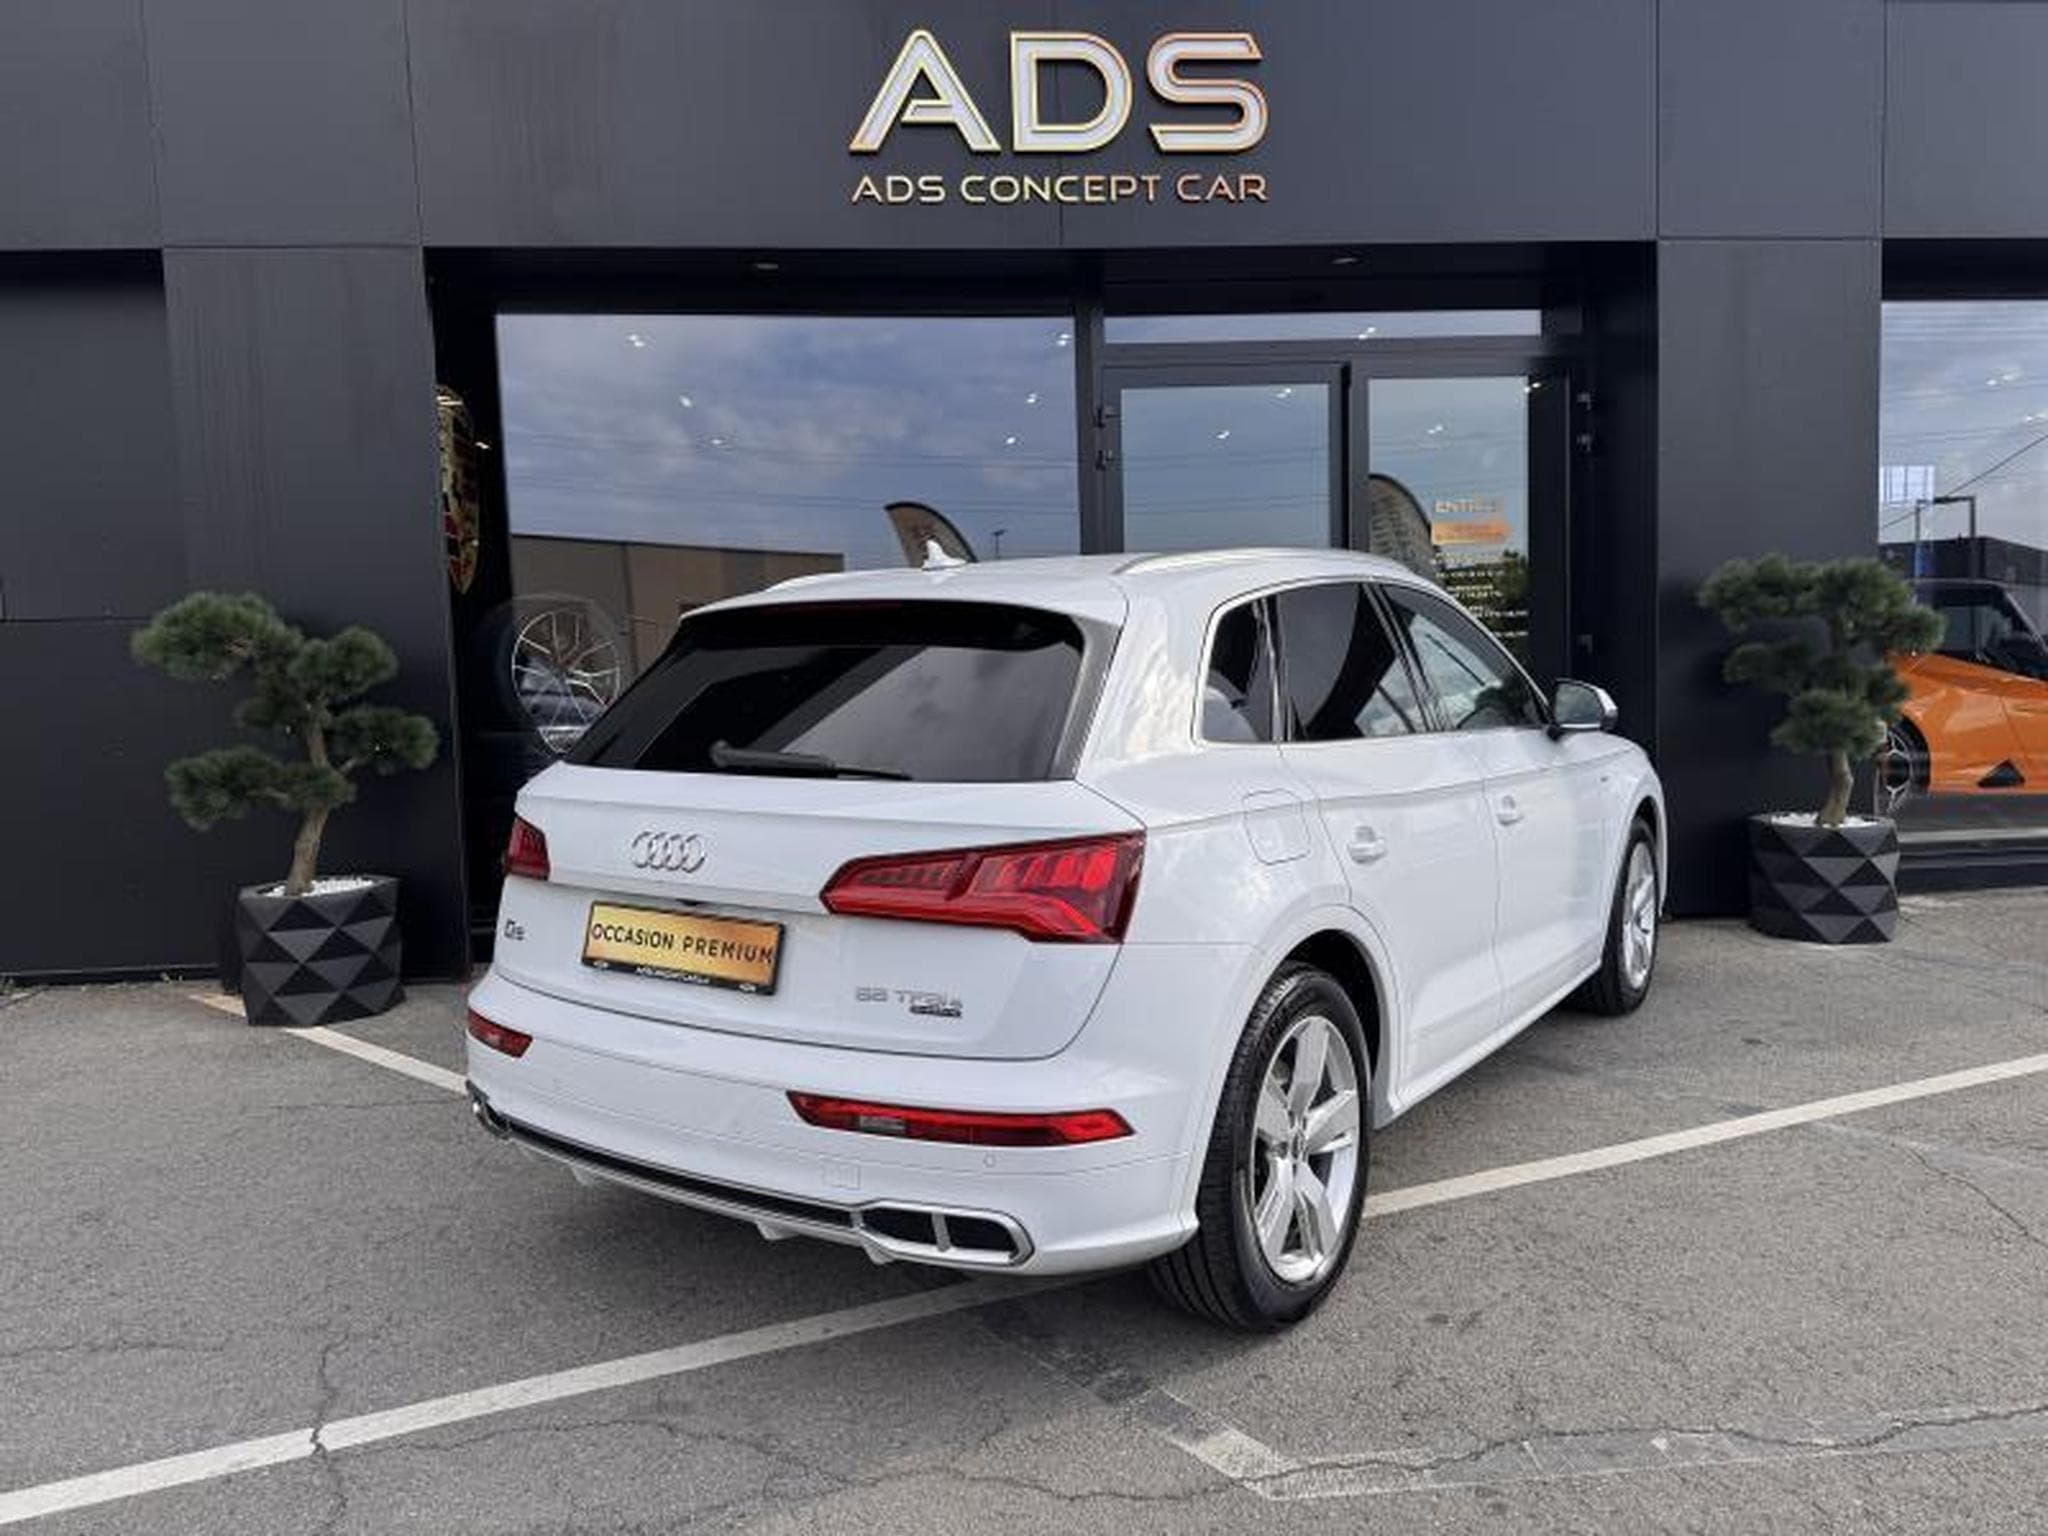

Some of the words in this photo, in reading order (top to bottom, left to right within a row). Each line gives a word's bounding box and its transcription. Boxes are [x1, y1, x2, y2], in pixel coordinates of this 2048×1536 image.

[849, 29, 1269, 153] ADS
[852, 175, 946, 203] ADS
[960, 175, 1161, 203] CONCEPT
[1176, 173, 1269, 201] CAR
[591, 923, 674, 950] OCCASION
[682, 935, 774, 964] PREMIUM
